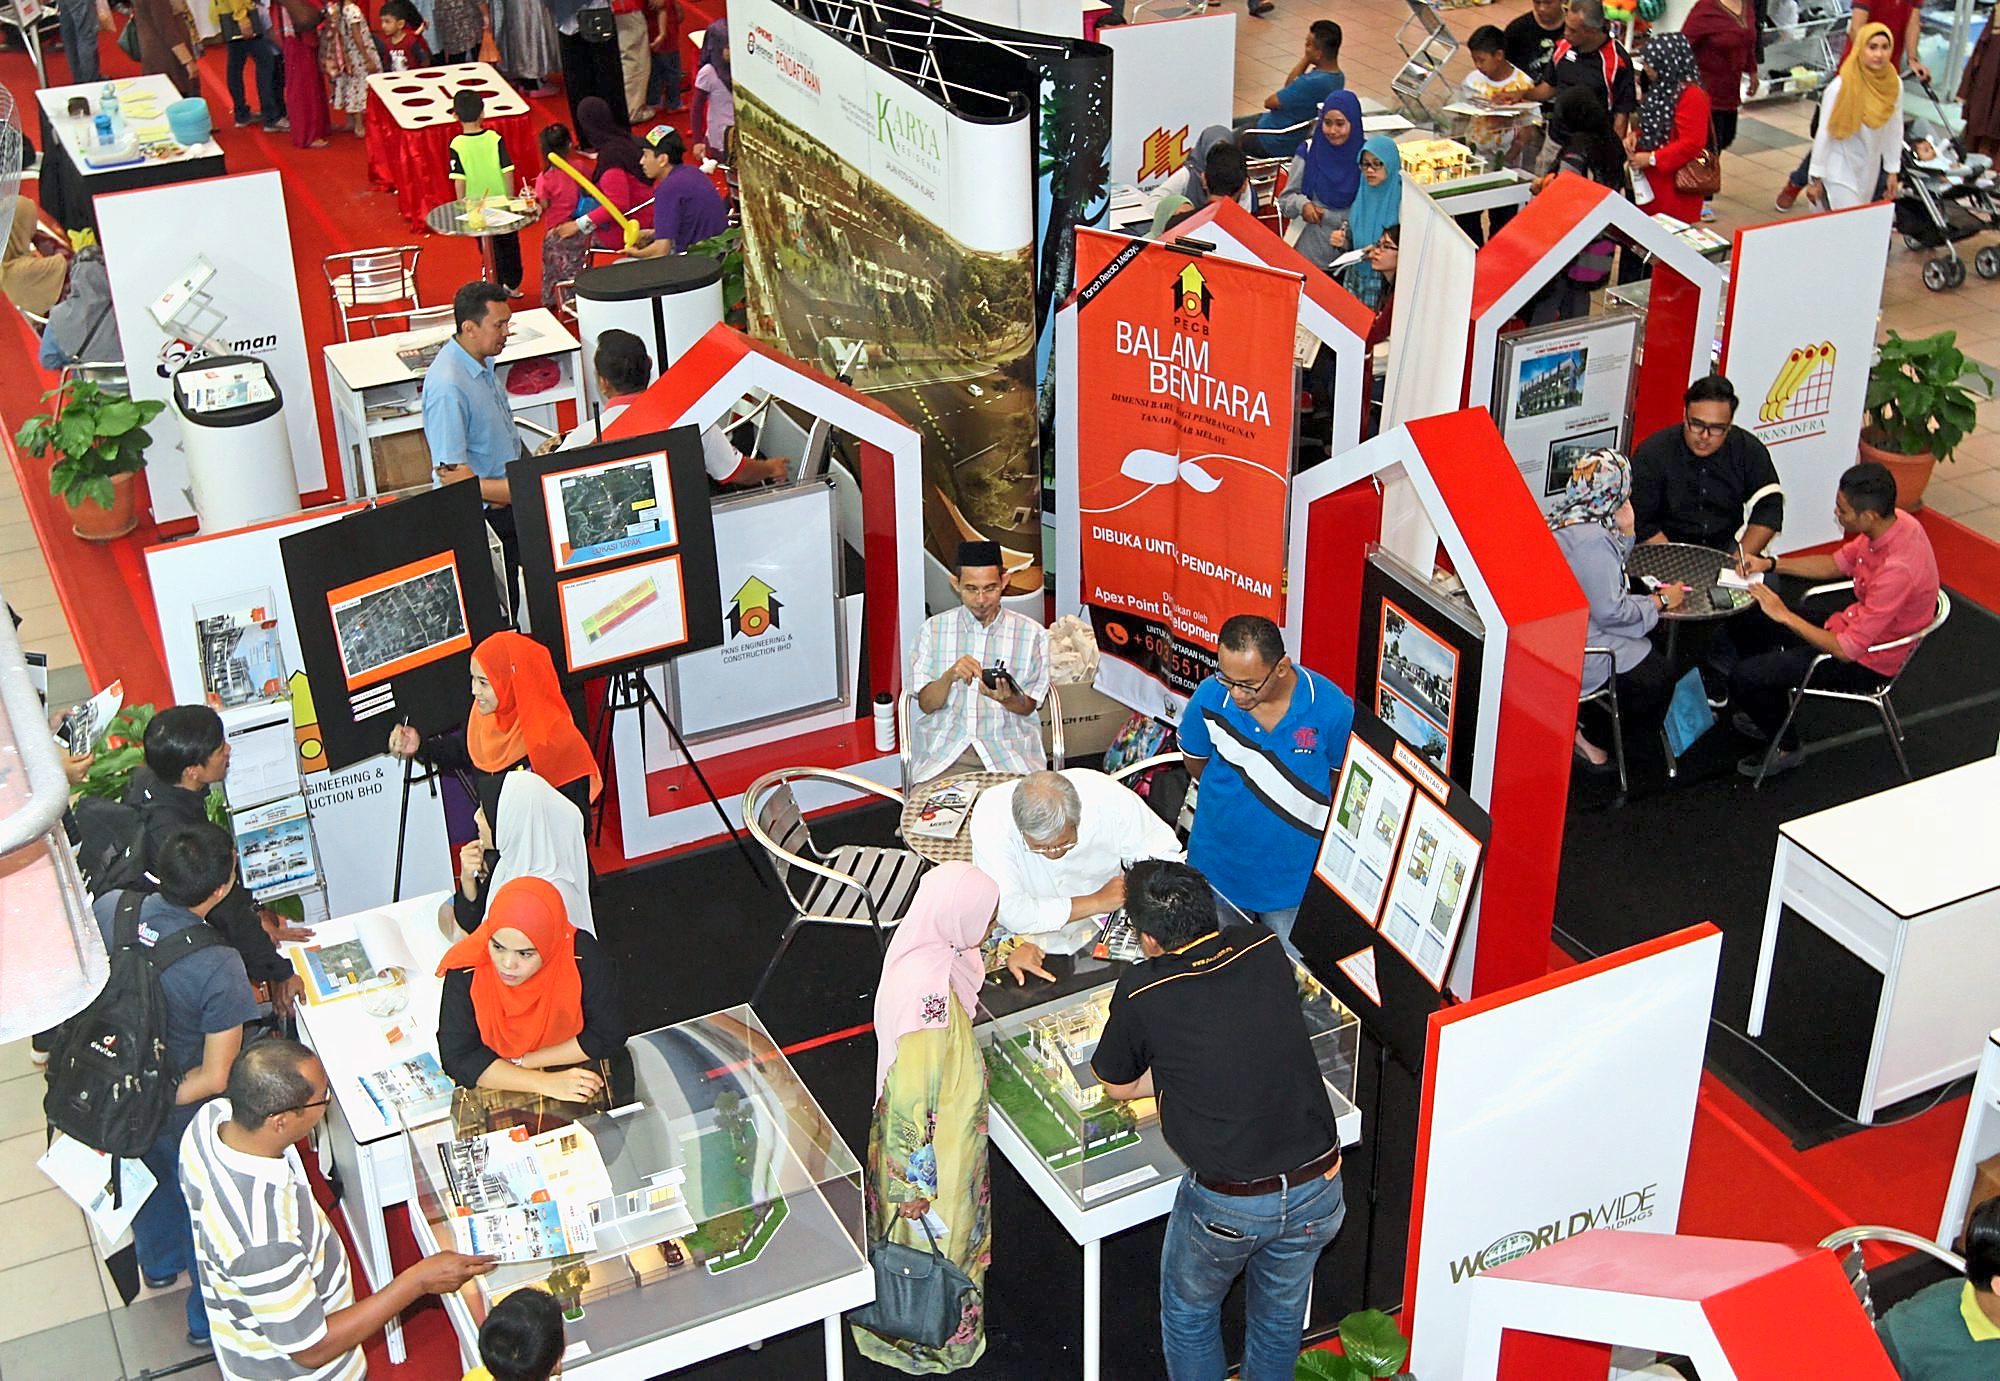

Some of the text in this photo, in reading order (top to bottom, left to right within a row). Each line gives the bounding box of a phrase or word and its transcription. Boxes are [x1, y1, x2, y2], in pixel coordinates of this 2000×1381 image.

[775, 49, 821, 96] PENDAFTARAN
[875, 90, 941, 161] KARYA
[1082, 280, 1102, 299] Tanah
[1174, 317, 1210, 336] PECB
[1115, 320, 1209, 374] BALAM
[1149, 360, 1271, 427] BENTARA
[1111, 392, 1149, 409] DIMENSI
[1193, 414, 1257, 440] PEMBANGUNAN
[1140, 413, 1171, 426] TANAH
[1194, 428, 1227, 445] MELAYU
[1757, 418, 1825, 442] PKNS INFRA
[1092, 525, 1142, 550] DIBUKA
[1181, 553, 1272, 599] PENDAFTARAN
[1095, 586, 1125, 604] Apex
[1128, 595, 1160, 614] Point
[1193, 608, 1209, 624] oleh
[721, 633, 793, 656] PKNS ENGINEERING &
[723, 642, 792, 664] CONSTRUCTION BHD
[1079, 714, 1101, 723] FILE
[307, 767, 384, 796] GINEERING &
[1398, 750, 1443, 795] BALAM BENTARA
[309, 782, 383, 810] UCTION BHD
[90, 1040, 117, 1058] deuter
[1449, 1182, 1658, 1285] WORLDWIDE
